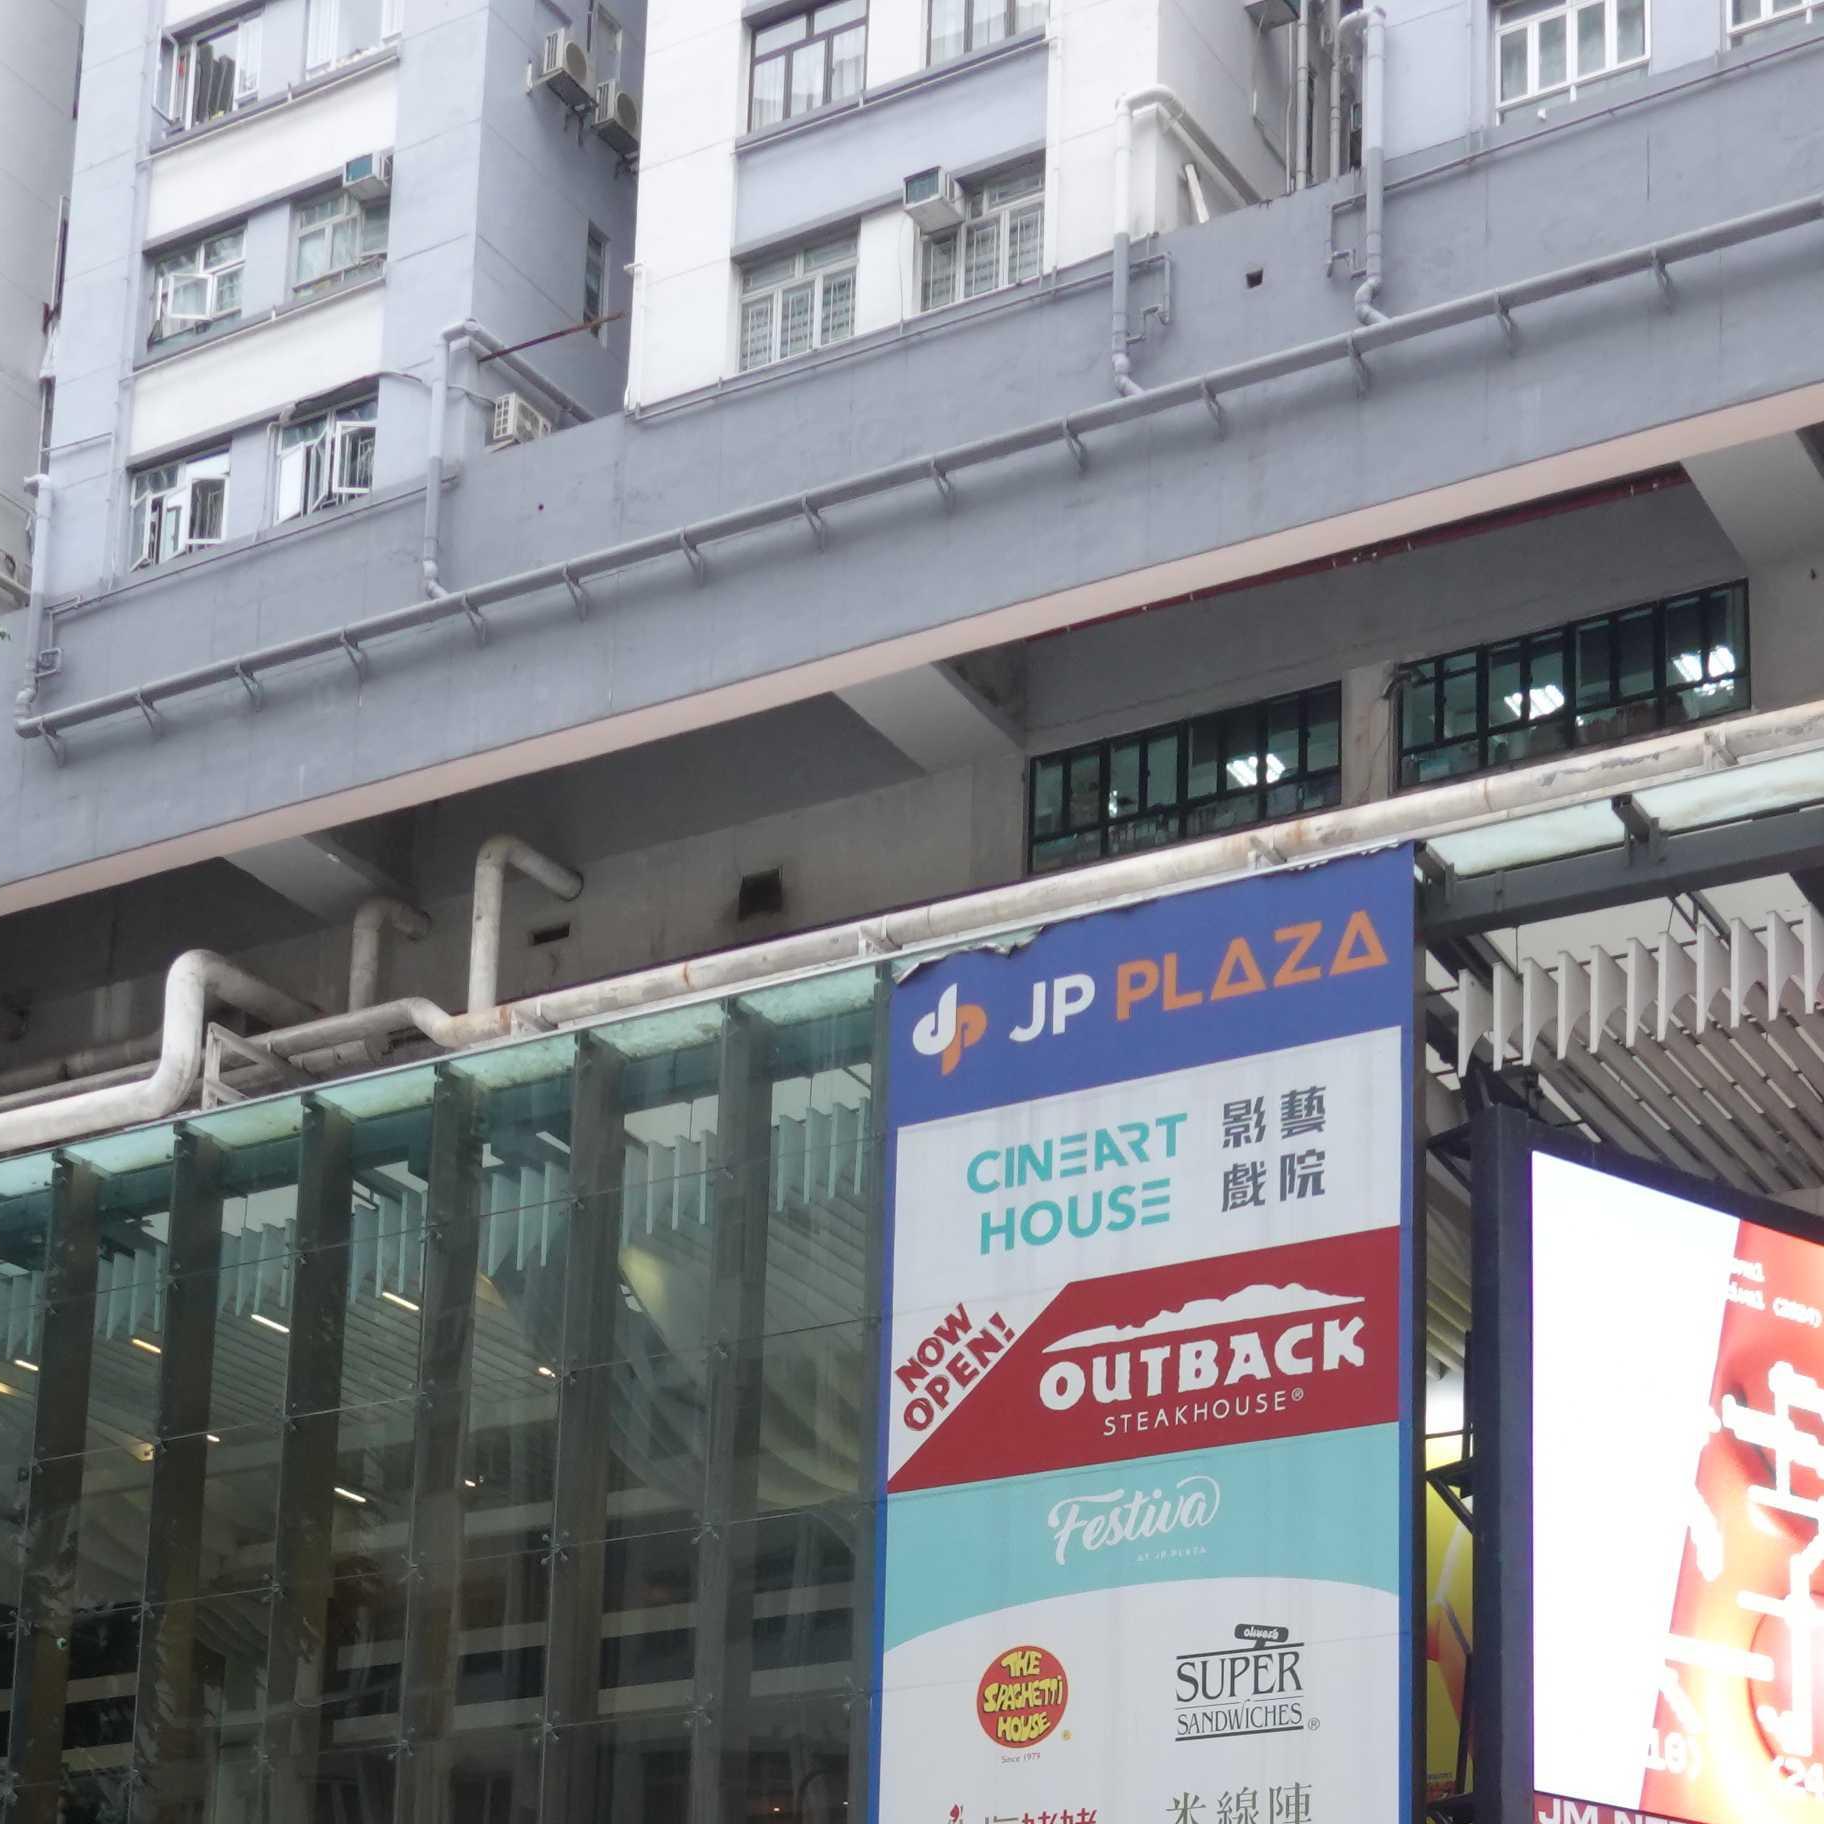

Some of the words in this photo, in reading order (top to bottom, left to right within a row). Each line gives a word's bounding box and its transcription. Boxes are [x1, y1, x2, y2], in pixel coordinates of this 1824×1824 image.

[1009, 974, 1095, 1041] JP
[1116, 910, 1388, 1021] PLAZA
[966, 1112, 1187, 1194] CINEART
[979, 1177, 1171, 1255] HOUSE
[895, 1303, 973, 1393] NOW
[903, 1311, 1017, 1431] OPEN!
[1040, 1316, 1365, 1410] OUTBACK
[1048, 1475, 1220, 1565] Festiva
[1001, 1650, 1042, 1677] THE
[1176, 1651, 1303, 1703] SUPER
[997, 1712, 1051, 1742] HOUSE
[1178, 1702, 1302, 1735] SANDWICHES
